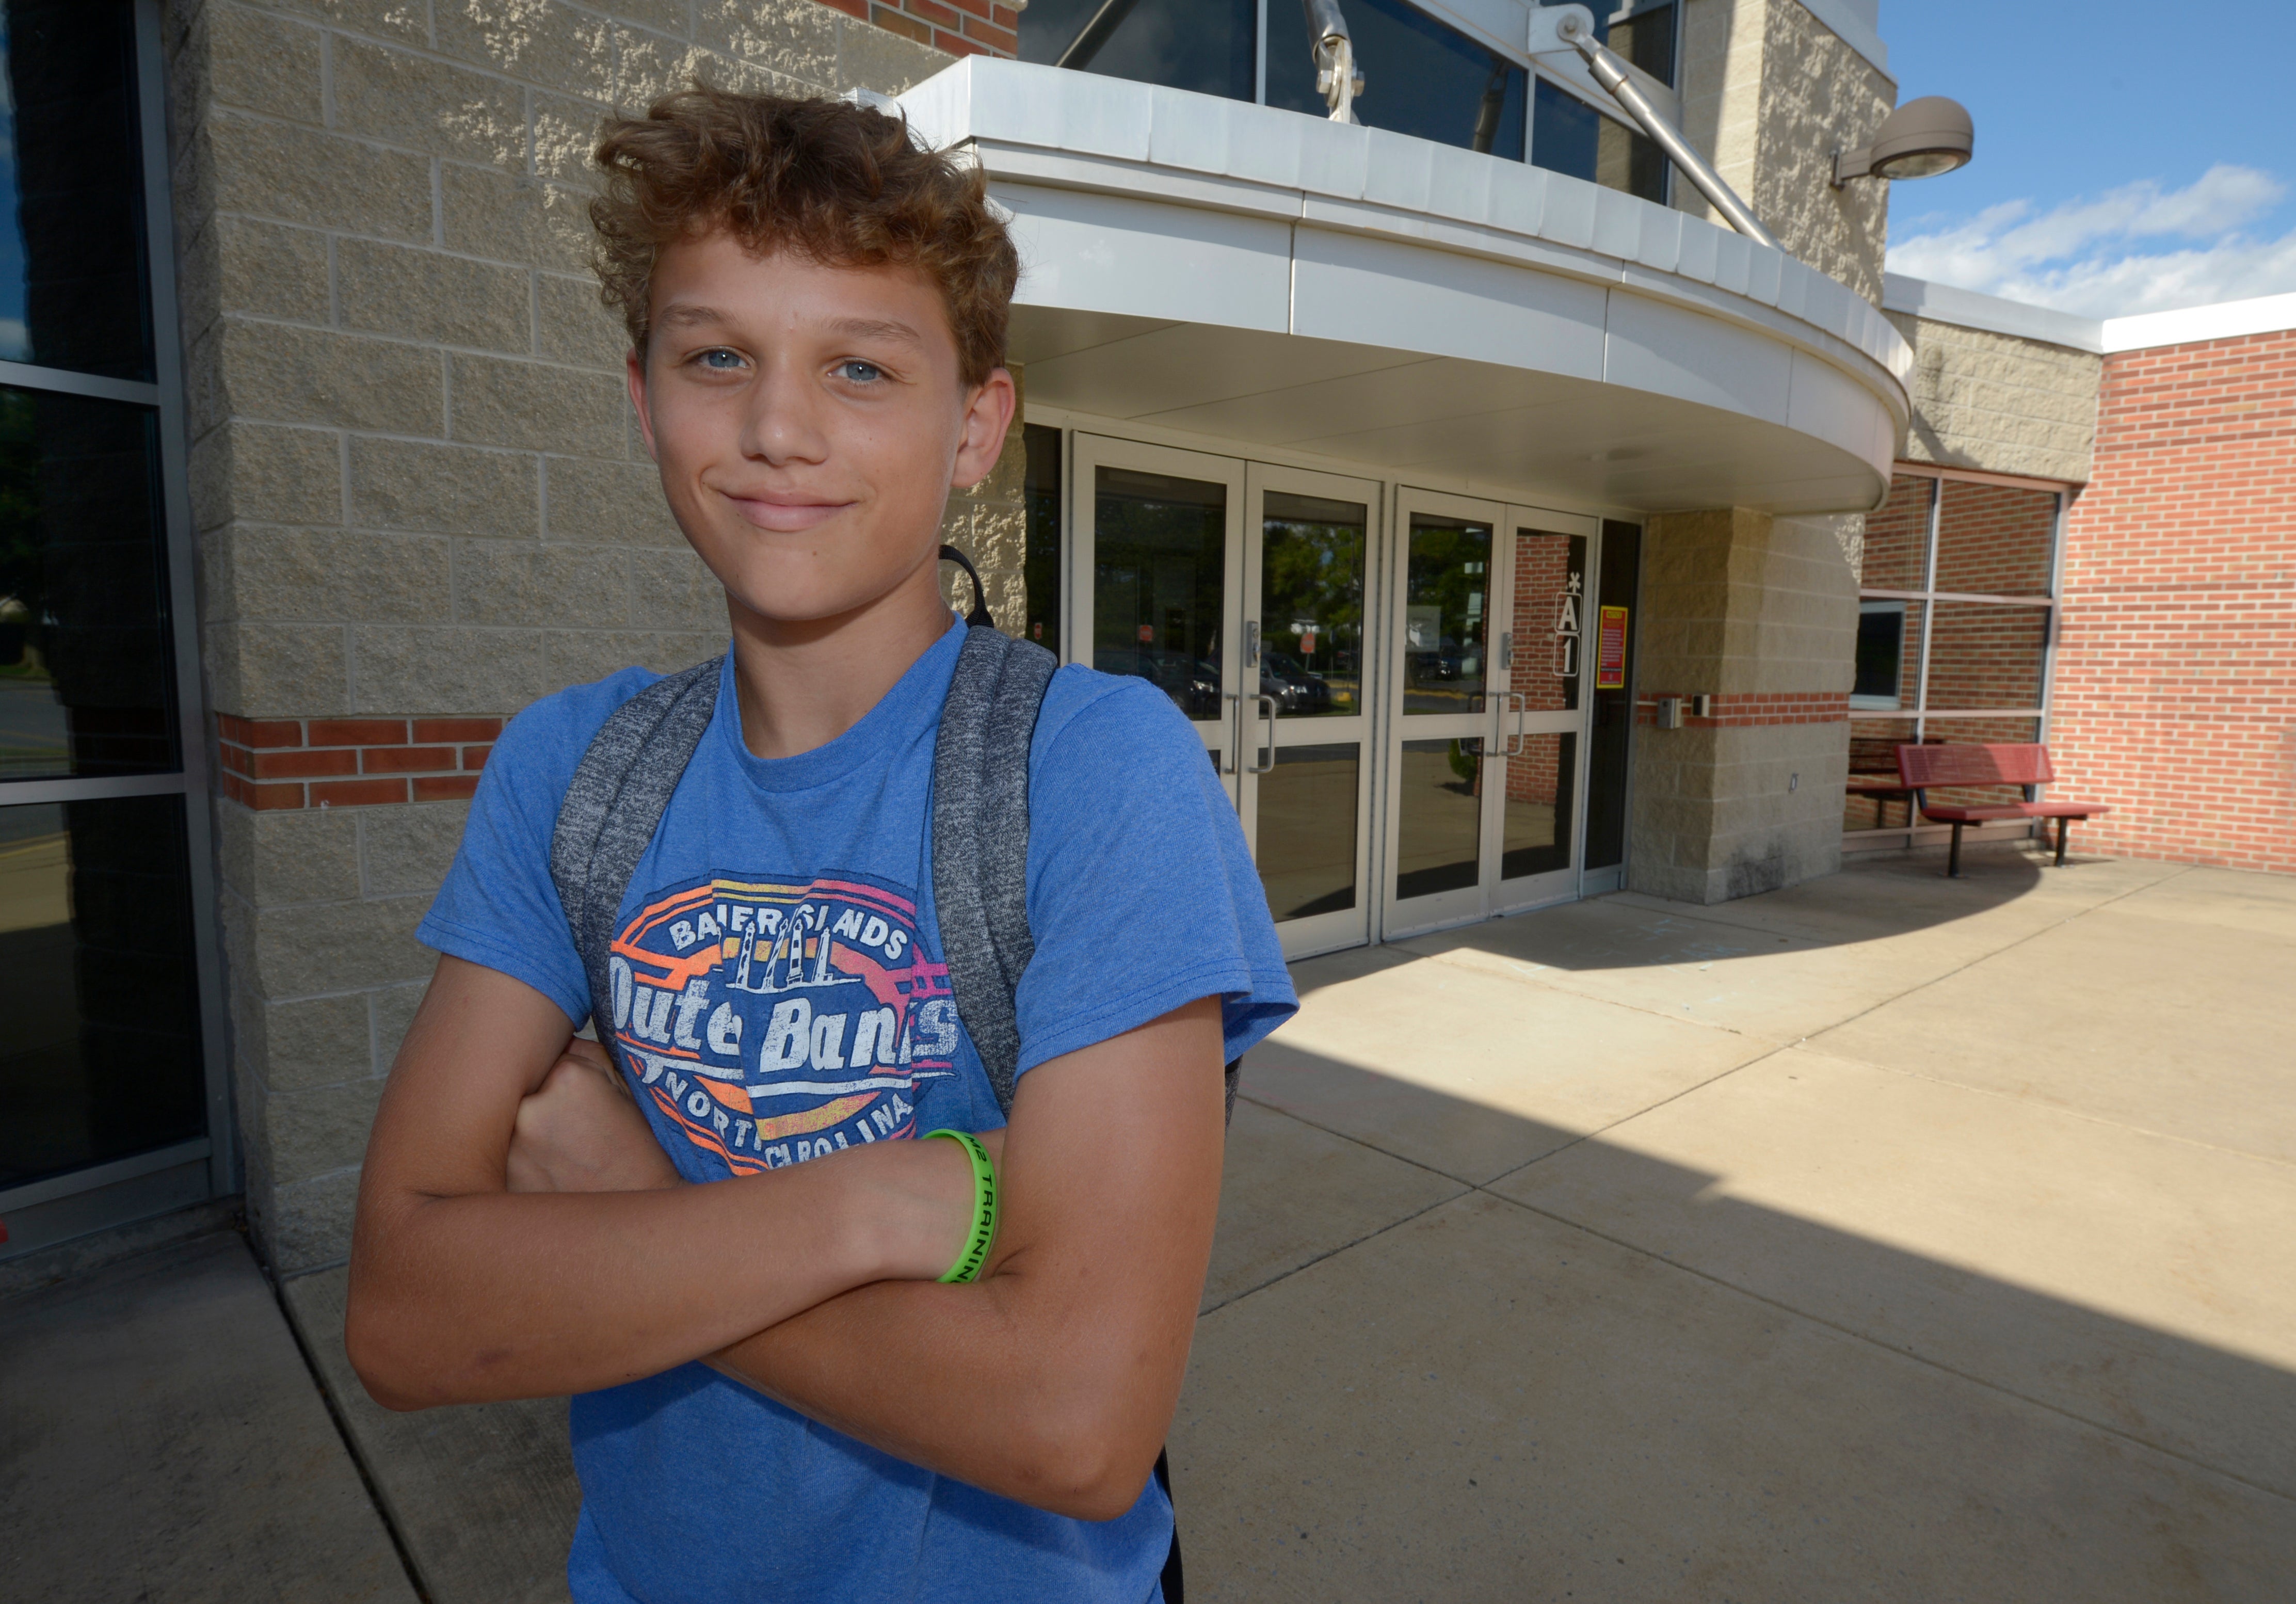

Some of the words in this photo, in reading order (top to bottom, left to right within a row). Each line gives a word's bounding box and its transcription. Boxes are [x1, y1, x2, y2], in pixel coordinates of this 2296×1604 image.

[1558, 596, 1578, 630] A
[1563, 638, 1571, 672] 1
[609, 956, 743, 1054] Oute
[951, 1174, 993, 1284] TRAININ
